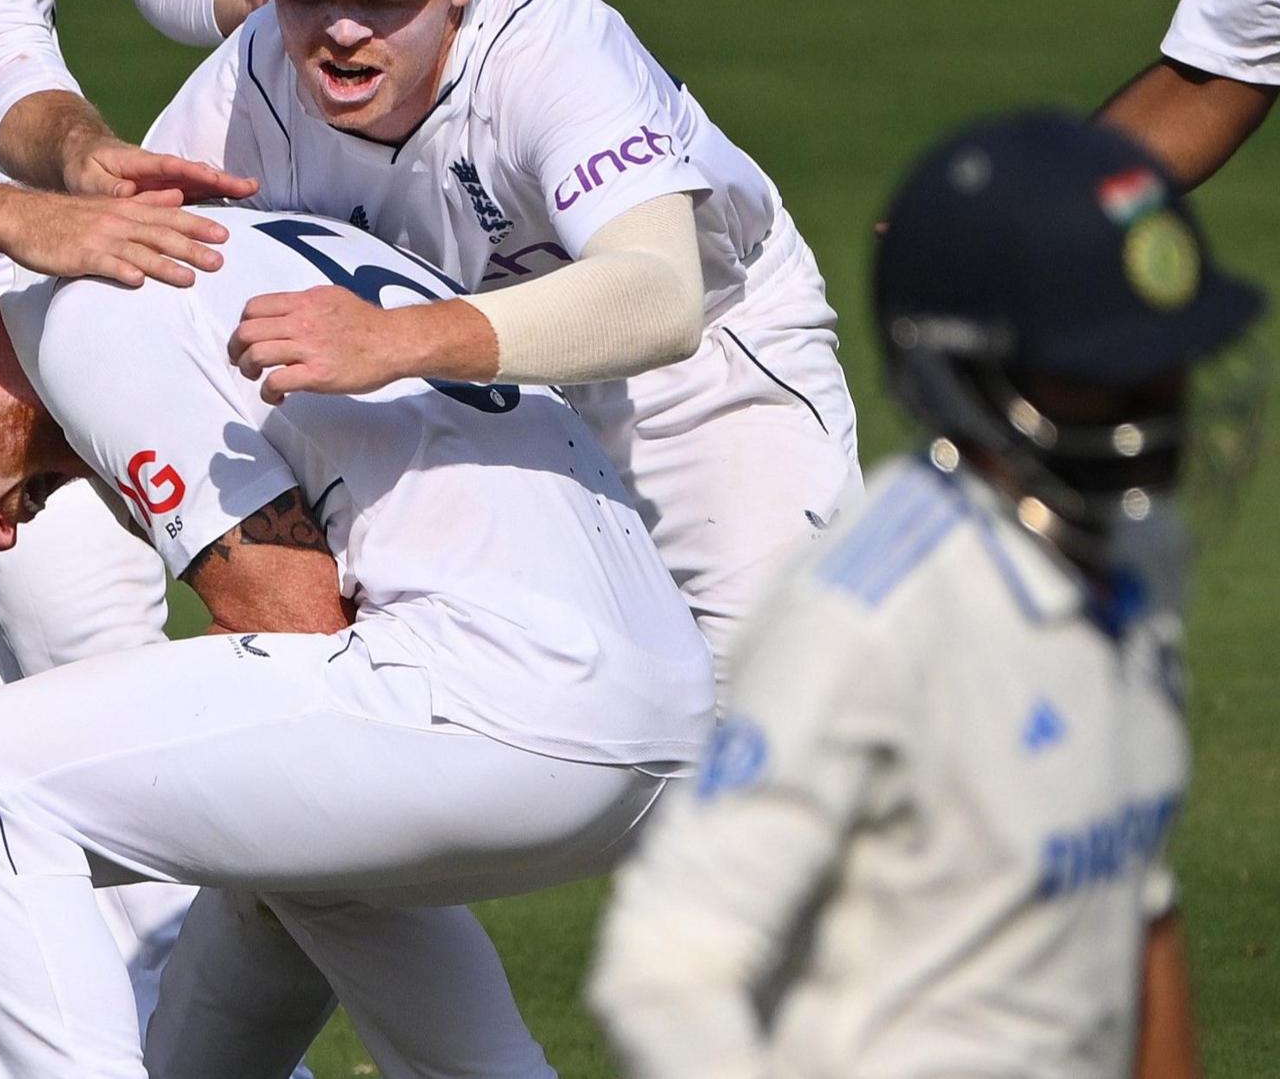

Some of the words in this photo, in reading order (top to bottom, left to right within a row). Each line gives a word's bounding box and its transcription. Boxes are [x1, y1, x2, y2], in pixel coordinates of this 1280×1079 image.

[555, 125, 676, 211] cinch
[114, 450, 186, 529] IG
[165, 515, 184, 540] BS
